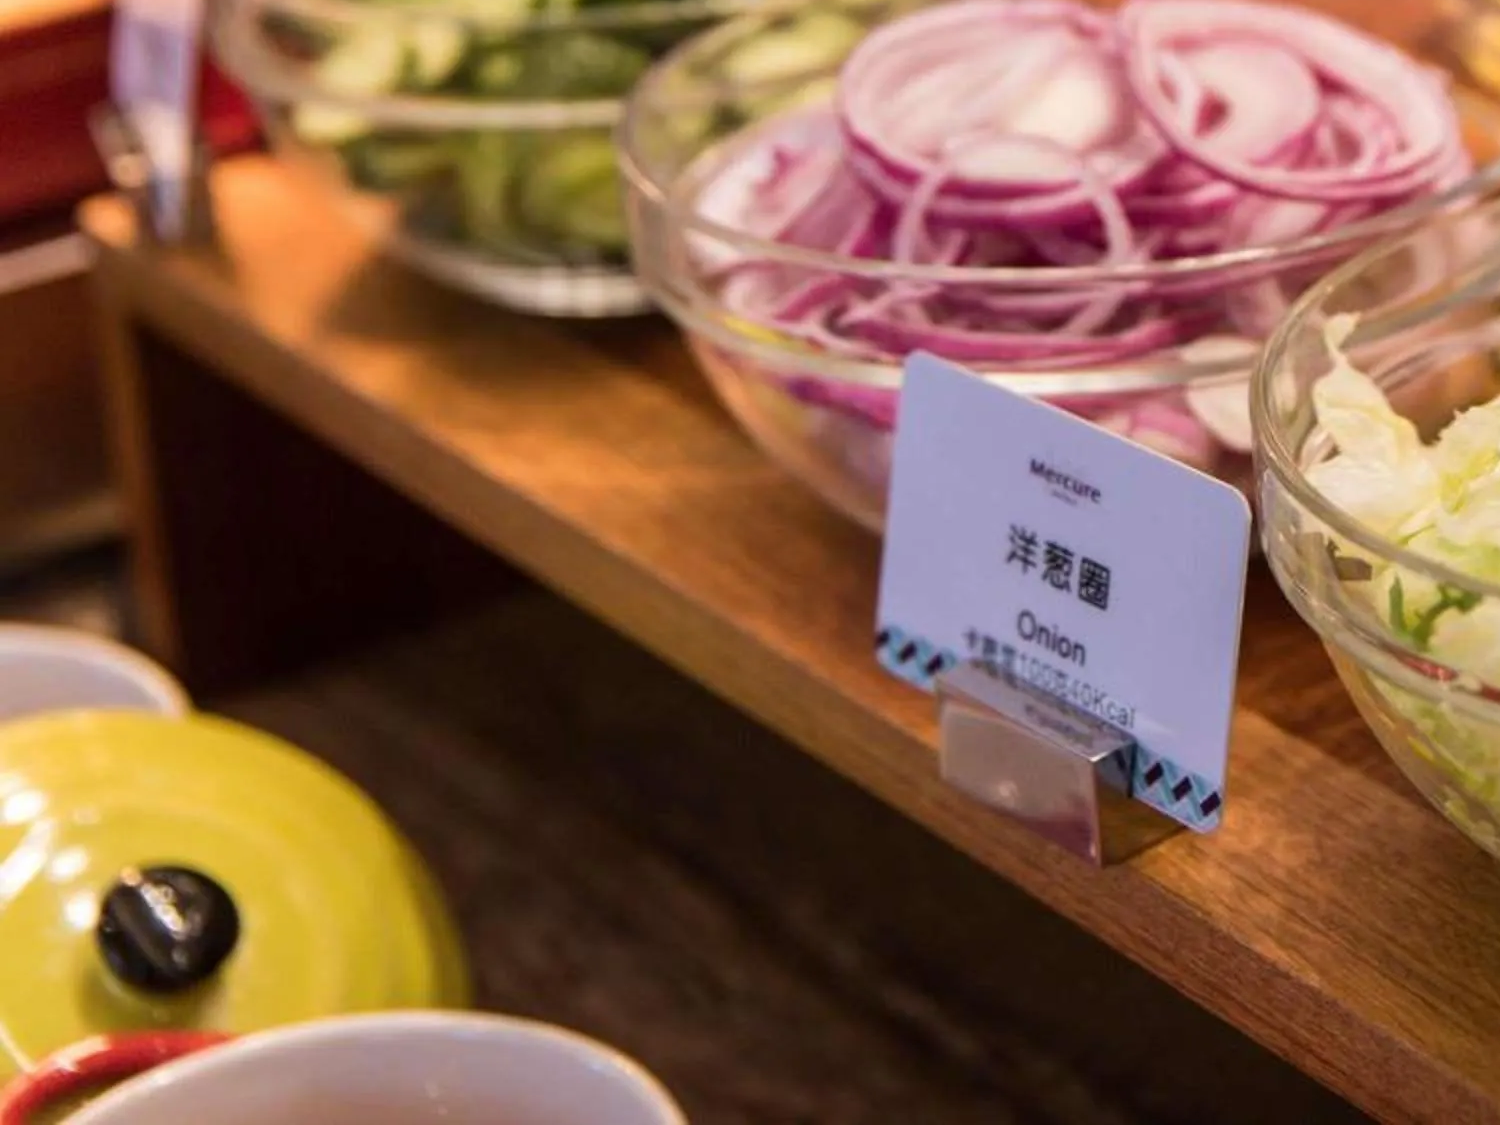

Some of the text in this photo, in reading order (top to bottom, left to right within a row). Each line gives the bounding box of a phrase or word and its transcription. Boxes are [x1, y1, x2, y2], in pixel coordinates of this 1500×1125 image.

[1029, 460, 1100, 503] Mercure
[1006, 524, 1110, 610] 洋葱圈
[1016, 610, 1086, 664] Onion
